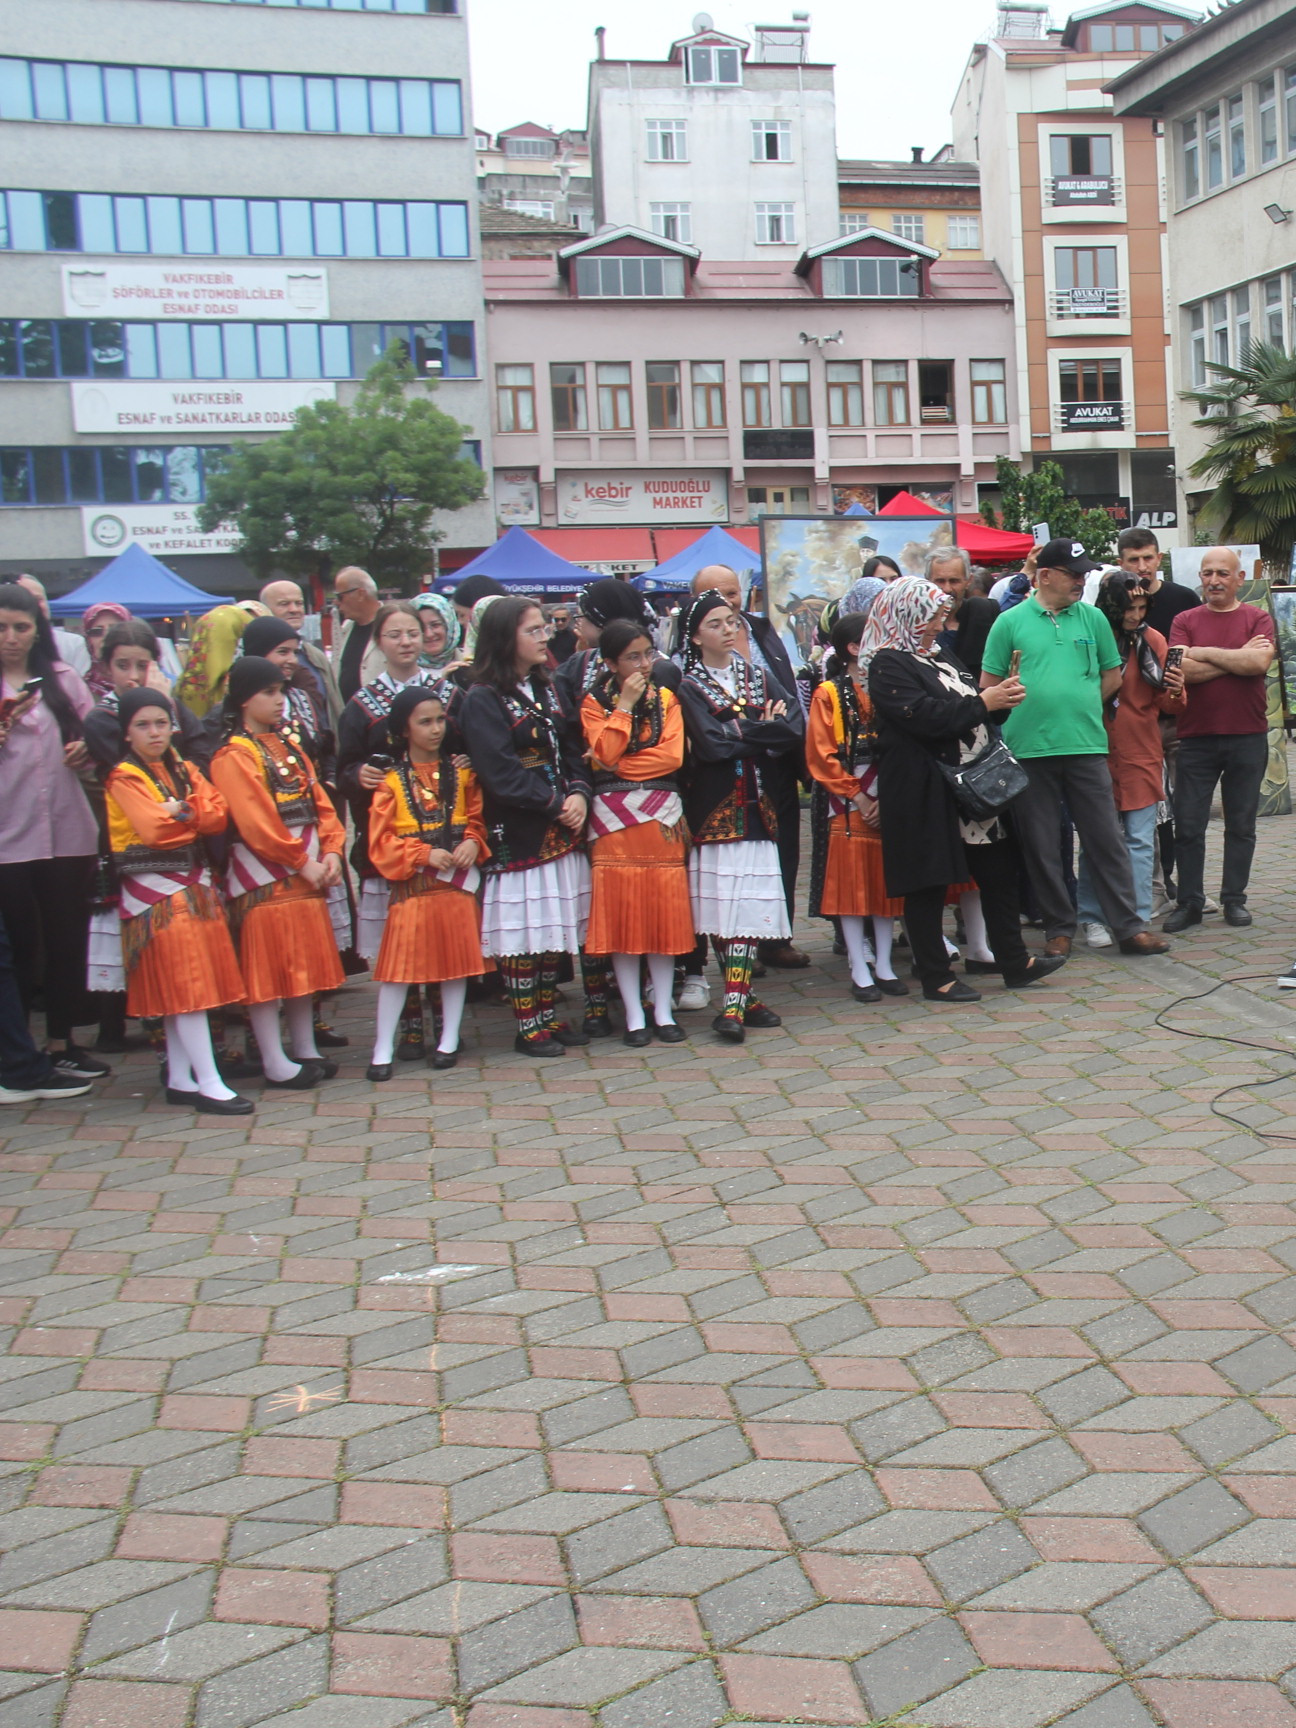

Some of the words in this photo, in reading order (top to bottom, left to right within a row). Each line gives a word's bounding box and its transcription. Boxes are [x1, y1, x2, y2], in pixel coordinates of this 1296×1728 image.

[163, 271, 234, 284] VAKFIKEBİR
[177, 290, 190, 299] ve
[193, 286, 284, 300] OTOMOBİLCİLER
[1073, 290, 1104, 298] AVUKAT
[163, 303, 200, 314] ESNAF
[204, 303, 238, 314] ODASI
[172, 390, 243, 405] VAKFIKEBİR
[118, 412, 157, 424] ESNAF
[160, 415, 173, 424] ve
[176, 412, 262, 424] SANATKARLAR
[1075, 406, 1114, 417] AVUKAT
[584, 481, 632, 499] kebir
[644, 477, 711, 494] KUDUOĞLU
[653, 496, 704, 509] MARKET
[1136, 511, 1176, 527] ALP
[132, 525, 169, 536] ESNAF
[172, 527, 184, 535] ve
[149, 541, 161, 549] ve
[164, 539, 213, 549] KEFALET
